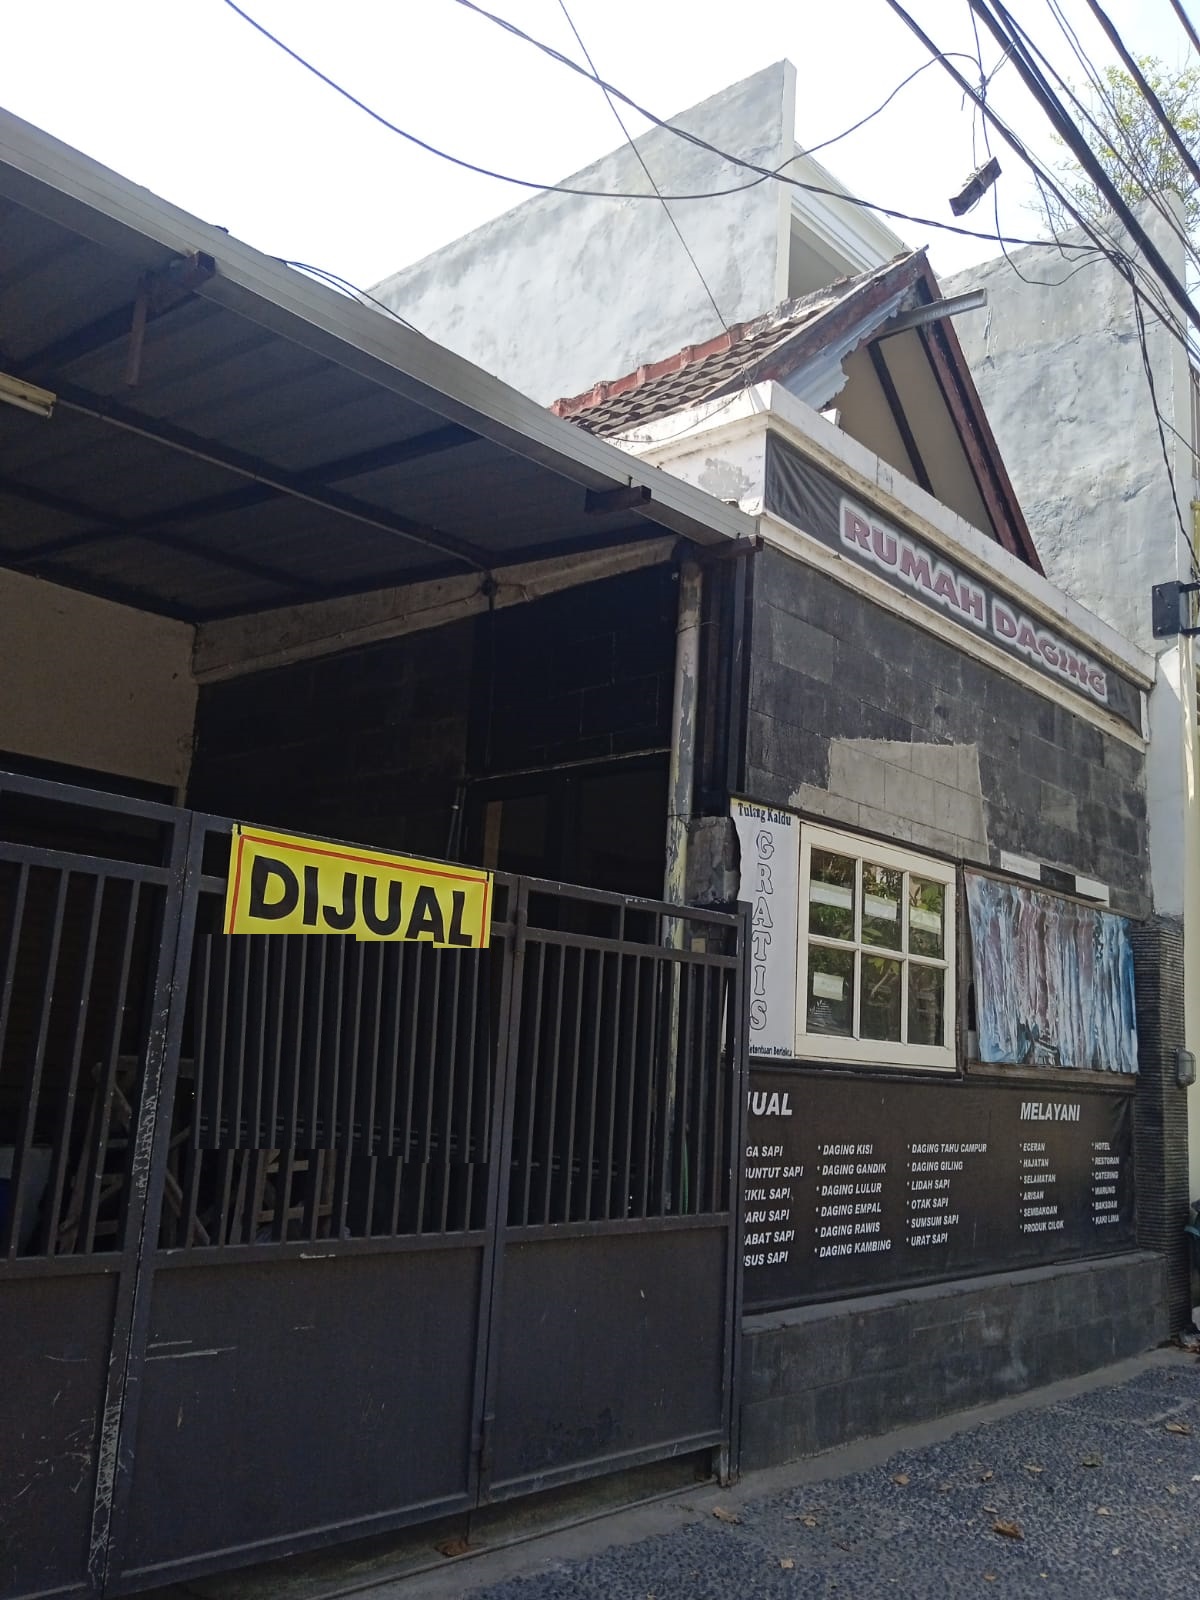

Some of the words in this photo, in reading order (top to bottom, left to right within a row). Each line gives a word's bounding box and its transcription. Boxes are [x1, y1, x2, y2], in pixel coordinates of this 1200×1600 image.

[841, 500, 986, 627] RUMAH
[993, 600, 1107, 700] DAGING
[738, 802, 766, 823] Tulang
[768, 807, 791, 826] Kaldu
[249, 855, 473, 947] DIJUAL
[749, 830, 775, 1031] GRATIS
[750, 1044, 772, 1054] etentuan
[1020, 1102, 1081, 1121] MELAYANI
[746, 1146, 758, 1157] GA
[761, 1146, 783, 1157] SAPI
[823, 1145, 855, 1155] DAGING
[857, 1144, 873, 1154] KISI
[911, 1144, 939, 1153] DAGING
[941, 1144, 959, 1153] TAHU
[960, 1143, 987, 1152] CAMPUR
[1023, 1142, 1046, 1151] ECERAN
[1094, 1142, 1110, 1150] HOTEL
[911, 1162, 939, 1172] DAGING
[940, 1161, 963, 1171] GILING
[1023, 1158, 1049, 1168] HAJATAN
[1094, 1156, 1120, 1165] RESTORAN
[745, 1167, 781, 1179] UNTUT
[783, 1166, 804, 1177] SAPI
[822, 1164, 854, 1176] DAGING
[856, 1163, 887, 1174] GANDIK
[1095, 1171, 1119, 1180] CATERING
[911, 1181, 933, 1191] LIDAH
[934, 1179, 950, 1189] SAPI
[1023, 1174, 1056, 1184] SELAMATAN
[769, 1187, 790, 1199] SAPI
[821, 1184, 854, 1197] DAGING
[855, 1183, 882, 1194] LULUR
[1023, 1191, 1044, 1200] ARISAN
[821, 1205, 853, 1217] DAGING
[855, 1202, 882, 1215] EMPAL
[911, 1199, 932, 1210] OTAK
[932, 1197, 949, 1208] SAPI
[744, 1211, 766, 1222] ARU
[768, 1209, 789, 1221] SAPI
[911, 1217, 942, 1228] SUMSUM
[943, 1214, 959, 1225] SAPI
[820, 1225, 853, 1238] DAGING
[854, 1222, 880, 1234] RAWIS
[1023, 1222, 1047, 1233] PRODUK
[1048, 1220, 1064, 1230] CILOK
[744, 1232, 770, 1245] ABAT
[773, 1230, 795, 1243] SAPI
[910, 1235, 931, 1246] URAT
[932, 1233, 948, 1244] SAPI
[819, 1244, 852, 1258] DAGING
[854, 1240, 892, 1254] KAMBING
[743, 1254, 765, 1266] SUS
[766, 1251, 788, 1264] SAPI
